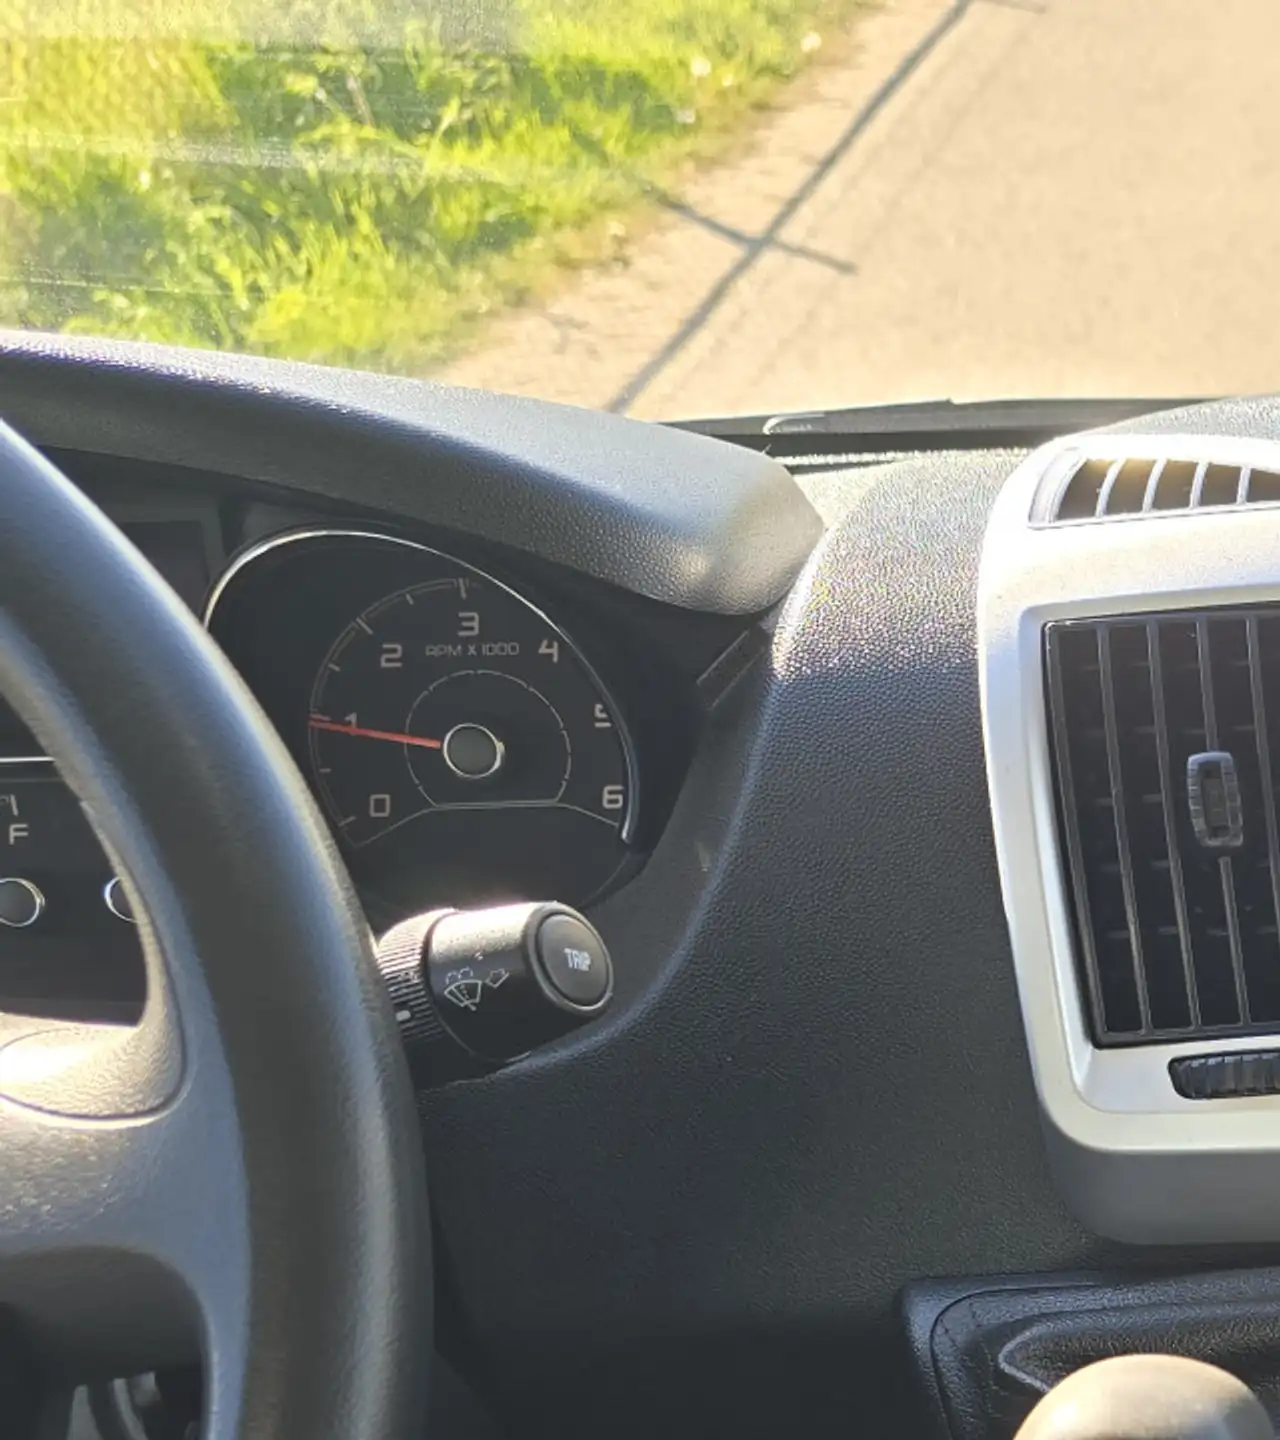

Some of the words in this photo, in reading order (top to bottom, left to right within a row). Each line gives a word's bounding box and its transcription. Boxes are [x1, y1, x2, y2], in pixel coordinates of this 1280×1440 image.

[457, 612, 479, 636] 3
[380, 644, 403, 668] 2
[425, 643, 462, 657] RPM
[482, 642, 519, 656] 1000
[538, 640, 559, 662] 4
[369, 794, 391, 817] 0
[602, 785, 625, 809] 6
[9, 823, 29, 846] F
